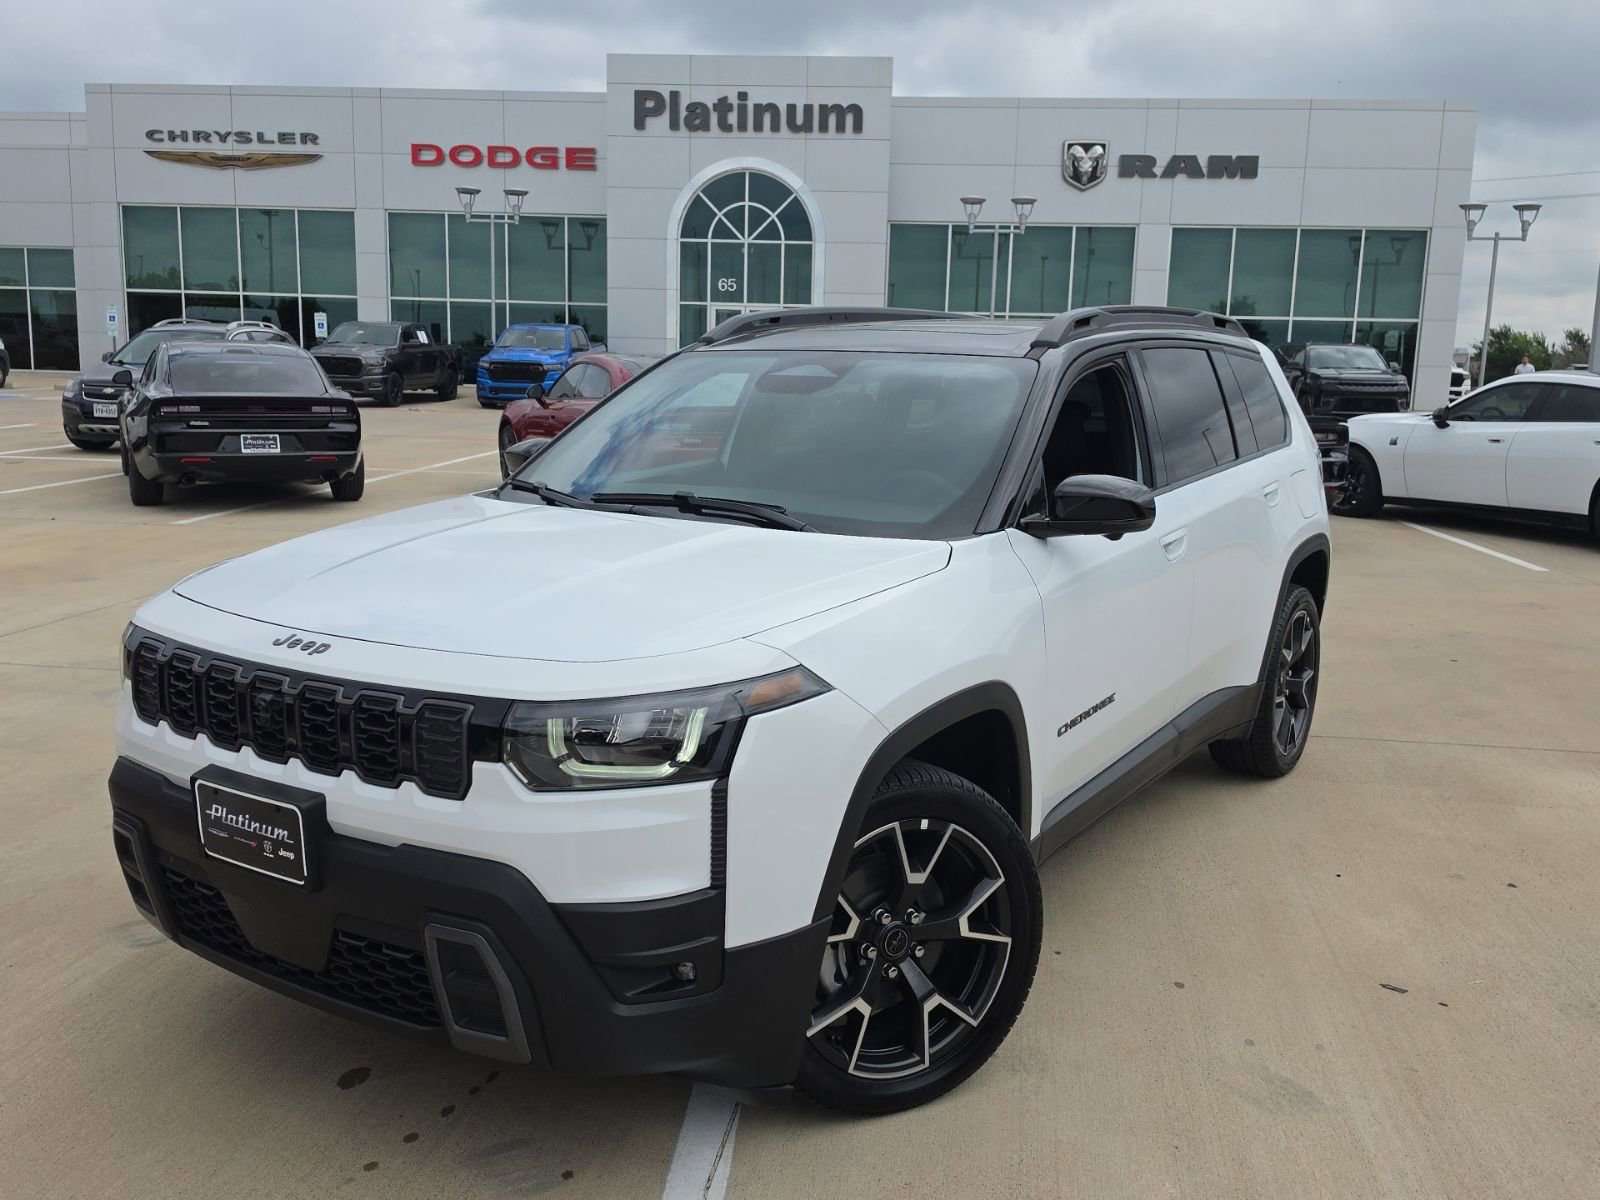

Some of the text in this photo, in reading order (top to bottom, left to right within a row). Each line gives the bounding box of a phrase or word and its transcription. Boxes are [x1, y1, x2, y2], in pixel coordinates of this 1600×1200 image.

[633, 89, 864, 134] Platinum
[145, 129, 320, 145] CHRYSLER
[410, 143, 597, 171] DODGE
[1117, 154, 1260, 179] RAM
[718, 278, 737, 291] 65
[272, 633, 332, 656] Jeep
[1057, 692, 1116, 737] CHEROKEE
[205, 804, 295, 844] Platinum
[278, 848, 295, 860] Jeep
